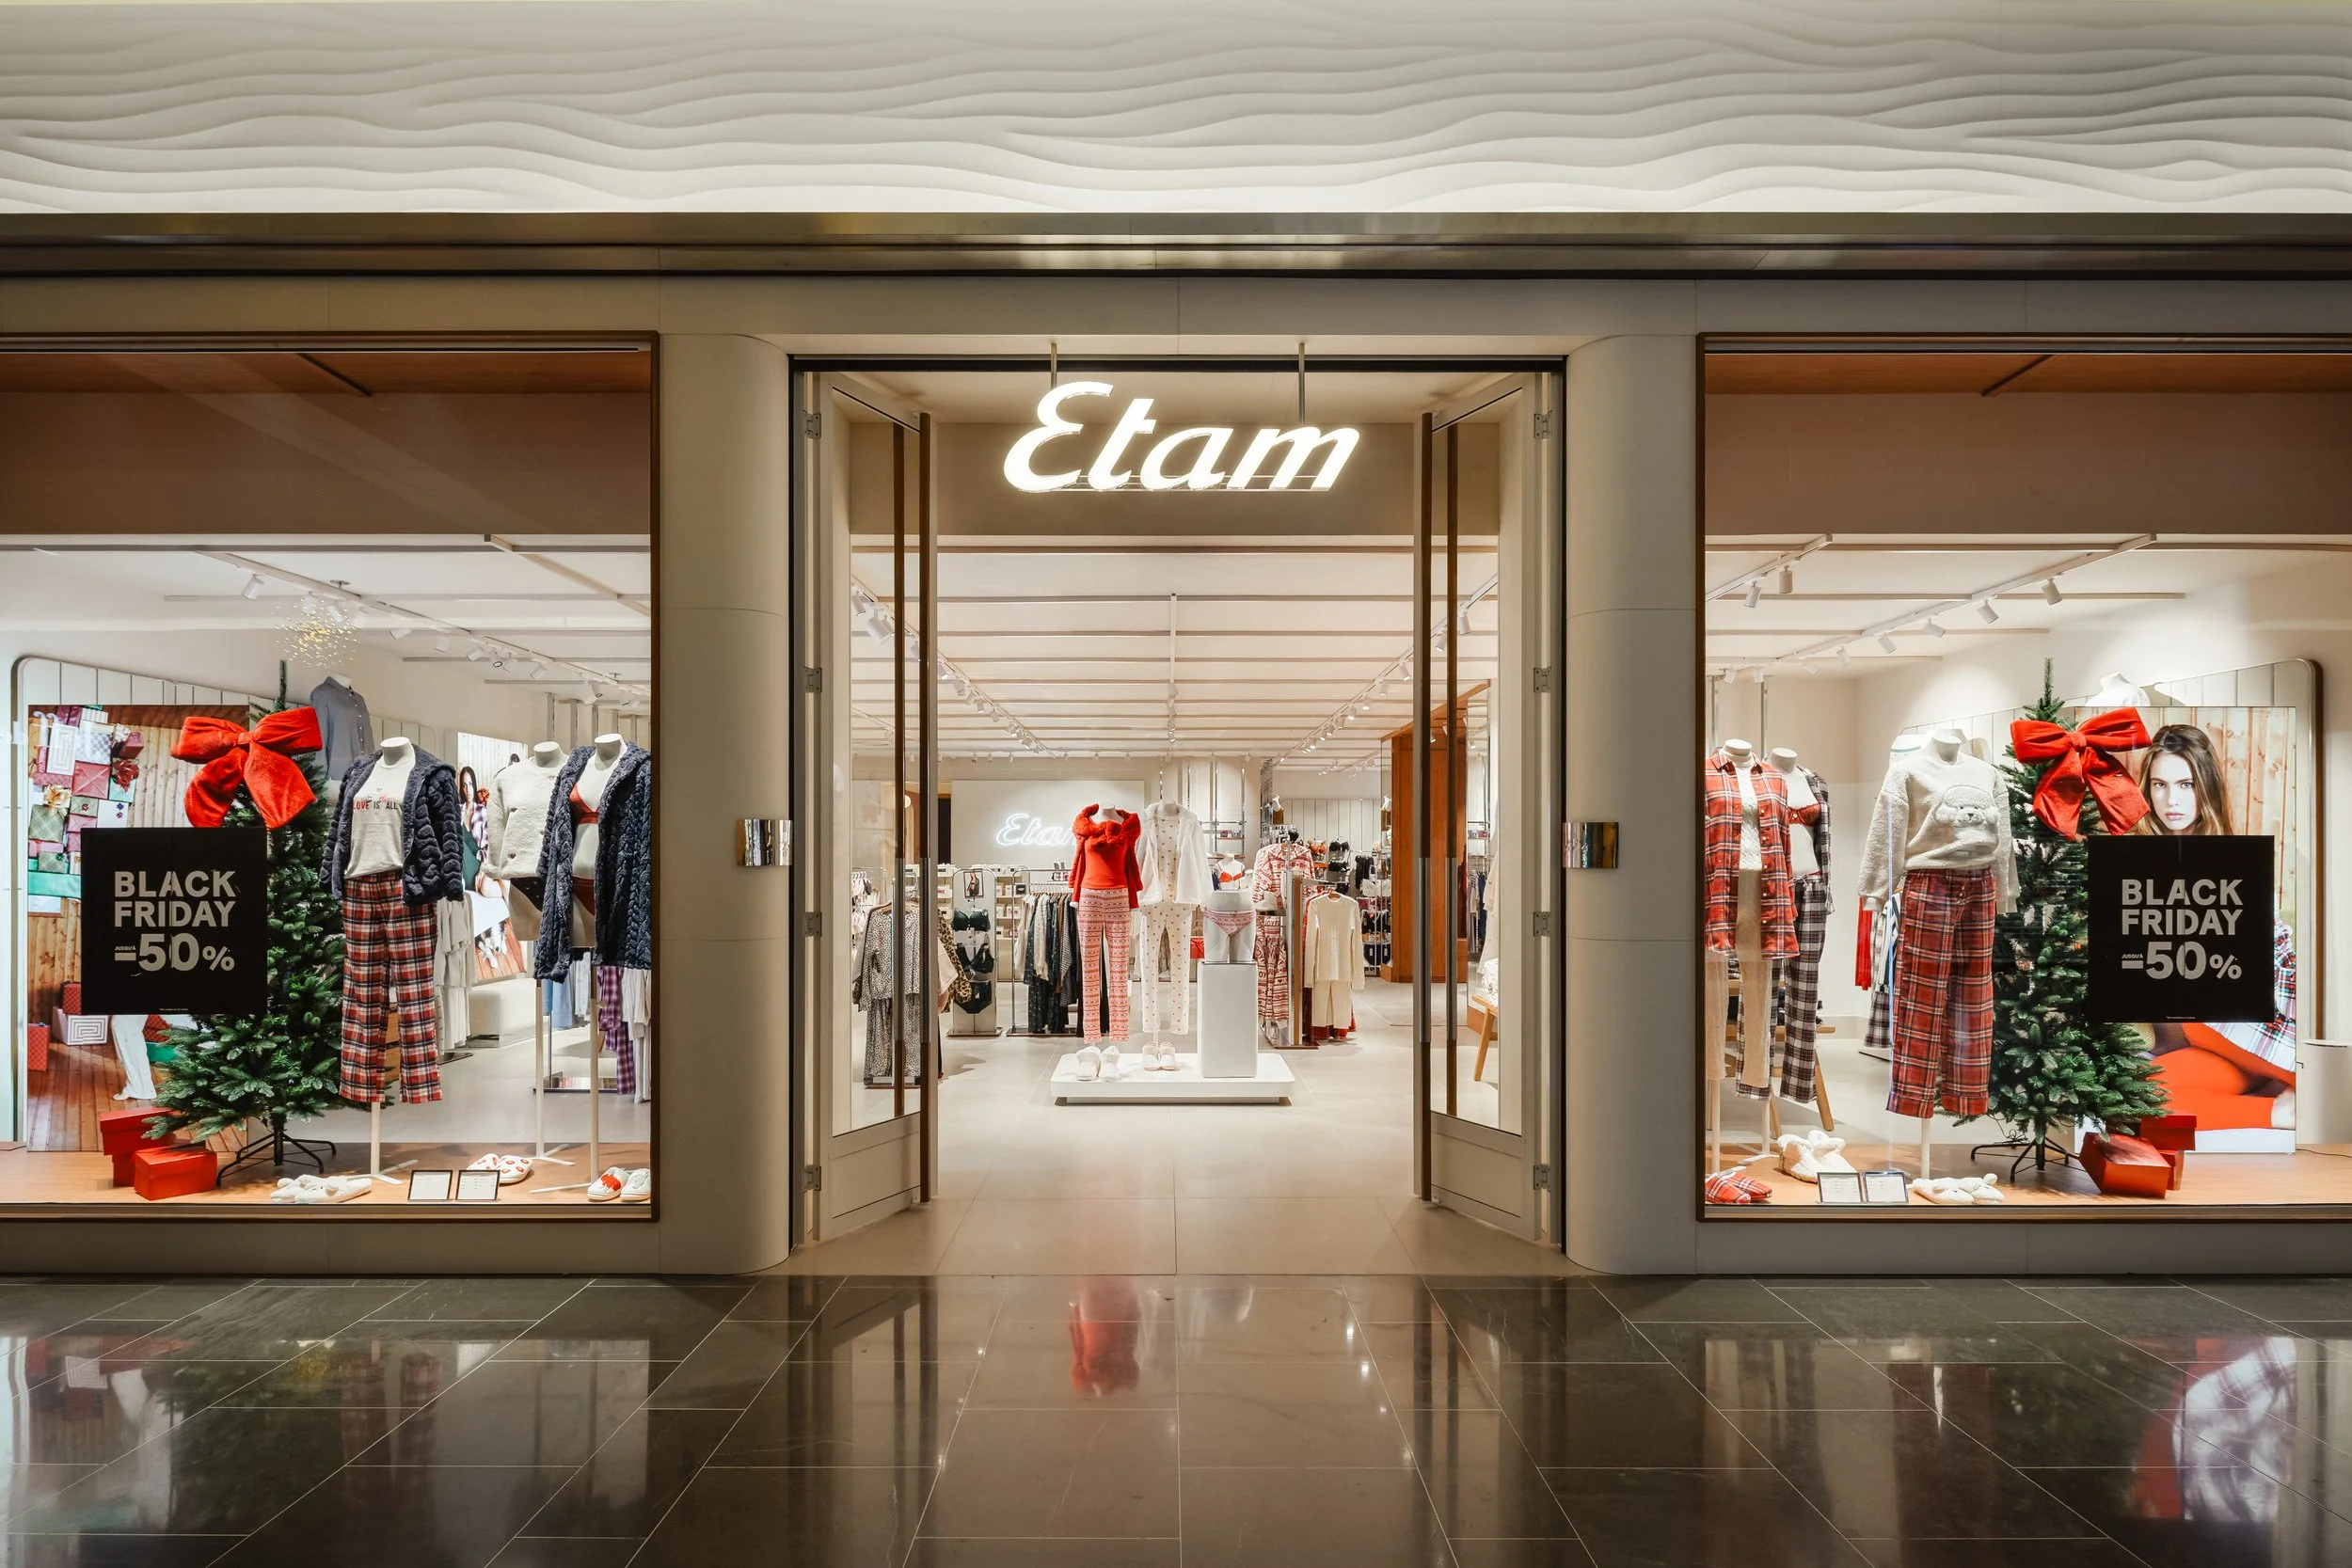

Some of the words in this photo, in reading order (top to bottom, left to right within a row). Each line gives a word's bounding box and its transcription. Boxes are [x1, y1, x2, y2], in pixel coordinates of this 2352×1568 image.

[1003, 381, 1360, 493] Etam
[353, 801, 369, 810] LOVE
[373, 801, 381, 810] IS
[386, 801, 397, 810] ALL
[996, 813, 1075, 846] Eta
[115, 870, 236, 897] BLACK
[2122, 879, 2243, 906] BLACK
[115, 901, 236, 927] FRIDAY
[2122, 909, 2243, 935] FRIDAY
